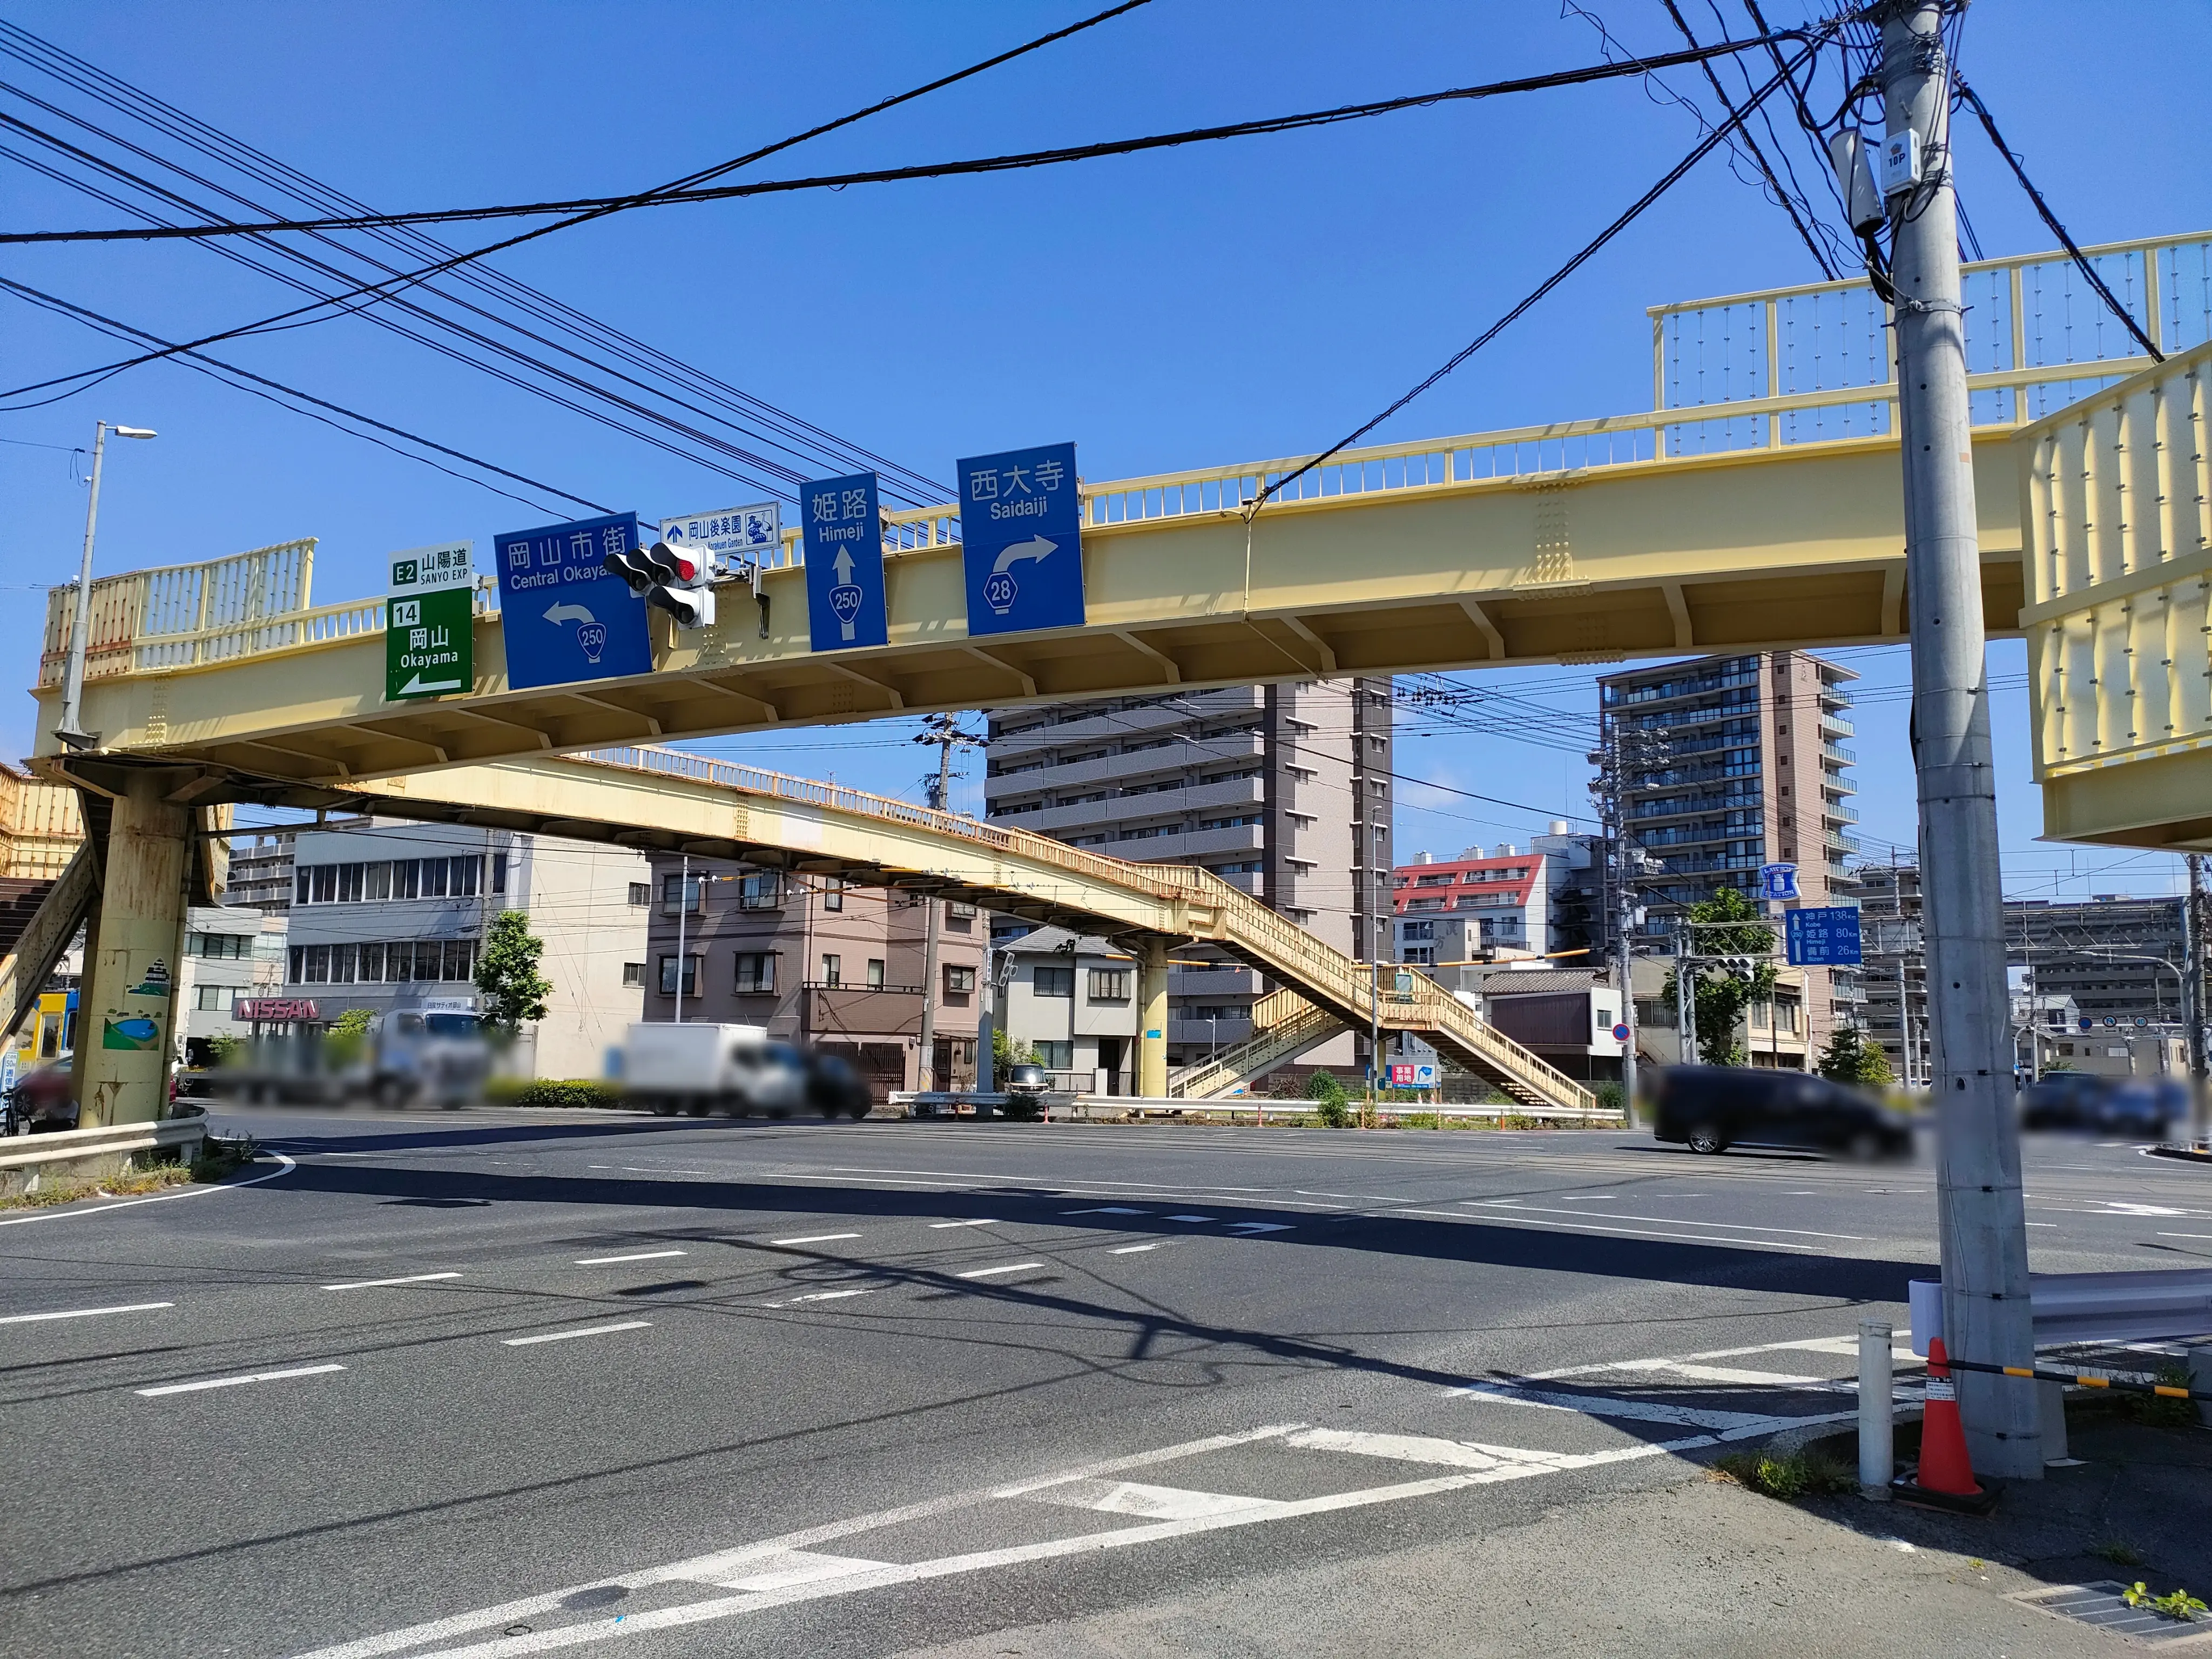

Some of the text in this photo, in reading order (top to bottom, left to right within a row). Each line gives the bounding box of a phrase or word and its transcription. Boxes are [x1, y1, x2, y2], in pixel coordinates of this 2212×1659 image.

[1889, 153, 1906, 167] 10P
[970, 460, 1064, 501] 西大寺
[812, 488, 867, 523] 姫路
[990, 496, 1047, 520] Saidaiji
[689, 515, 741, 541] 岡山後楽園
[819, 522, 864, 543] Himeji
[508, 527, 625, 571] 岡山市街
[708, 541, 727, 550] Korakuen
[727, 537, 743, 548] Garden
[422, 548, 467, 572] 山陽道
[396, 564, 414, 581] E2
[421, 568, 468, 585] SANYO EXP
[511, 569, 558, 590] Central
[991, 580, 1010, 601] 28
[835, 591, 858, 610] 250
[396, 604, 417, 623] 14
[410, 625, 448, 651] 岡山
[582, 629, 603, 646] 250
[401, 651, 458, 669] Okayama
[1805, 912, 1827, 921] 神戸
[1806, 929, 1829, 939] 姫路
[1807, 946, 1830, 956] 備前
[238, 999, 320, 1019] NISSAN
